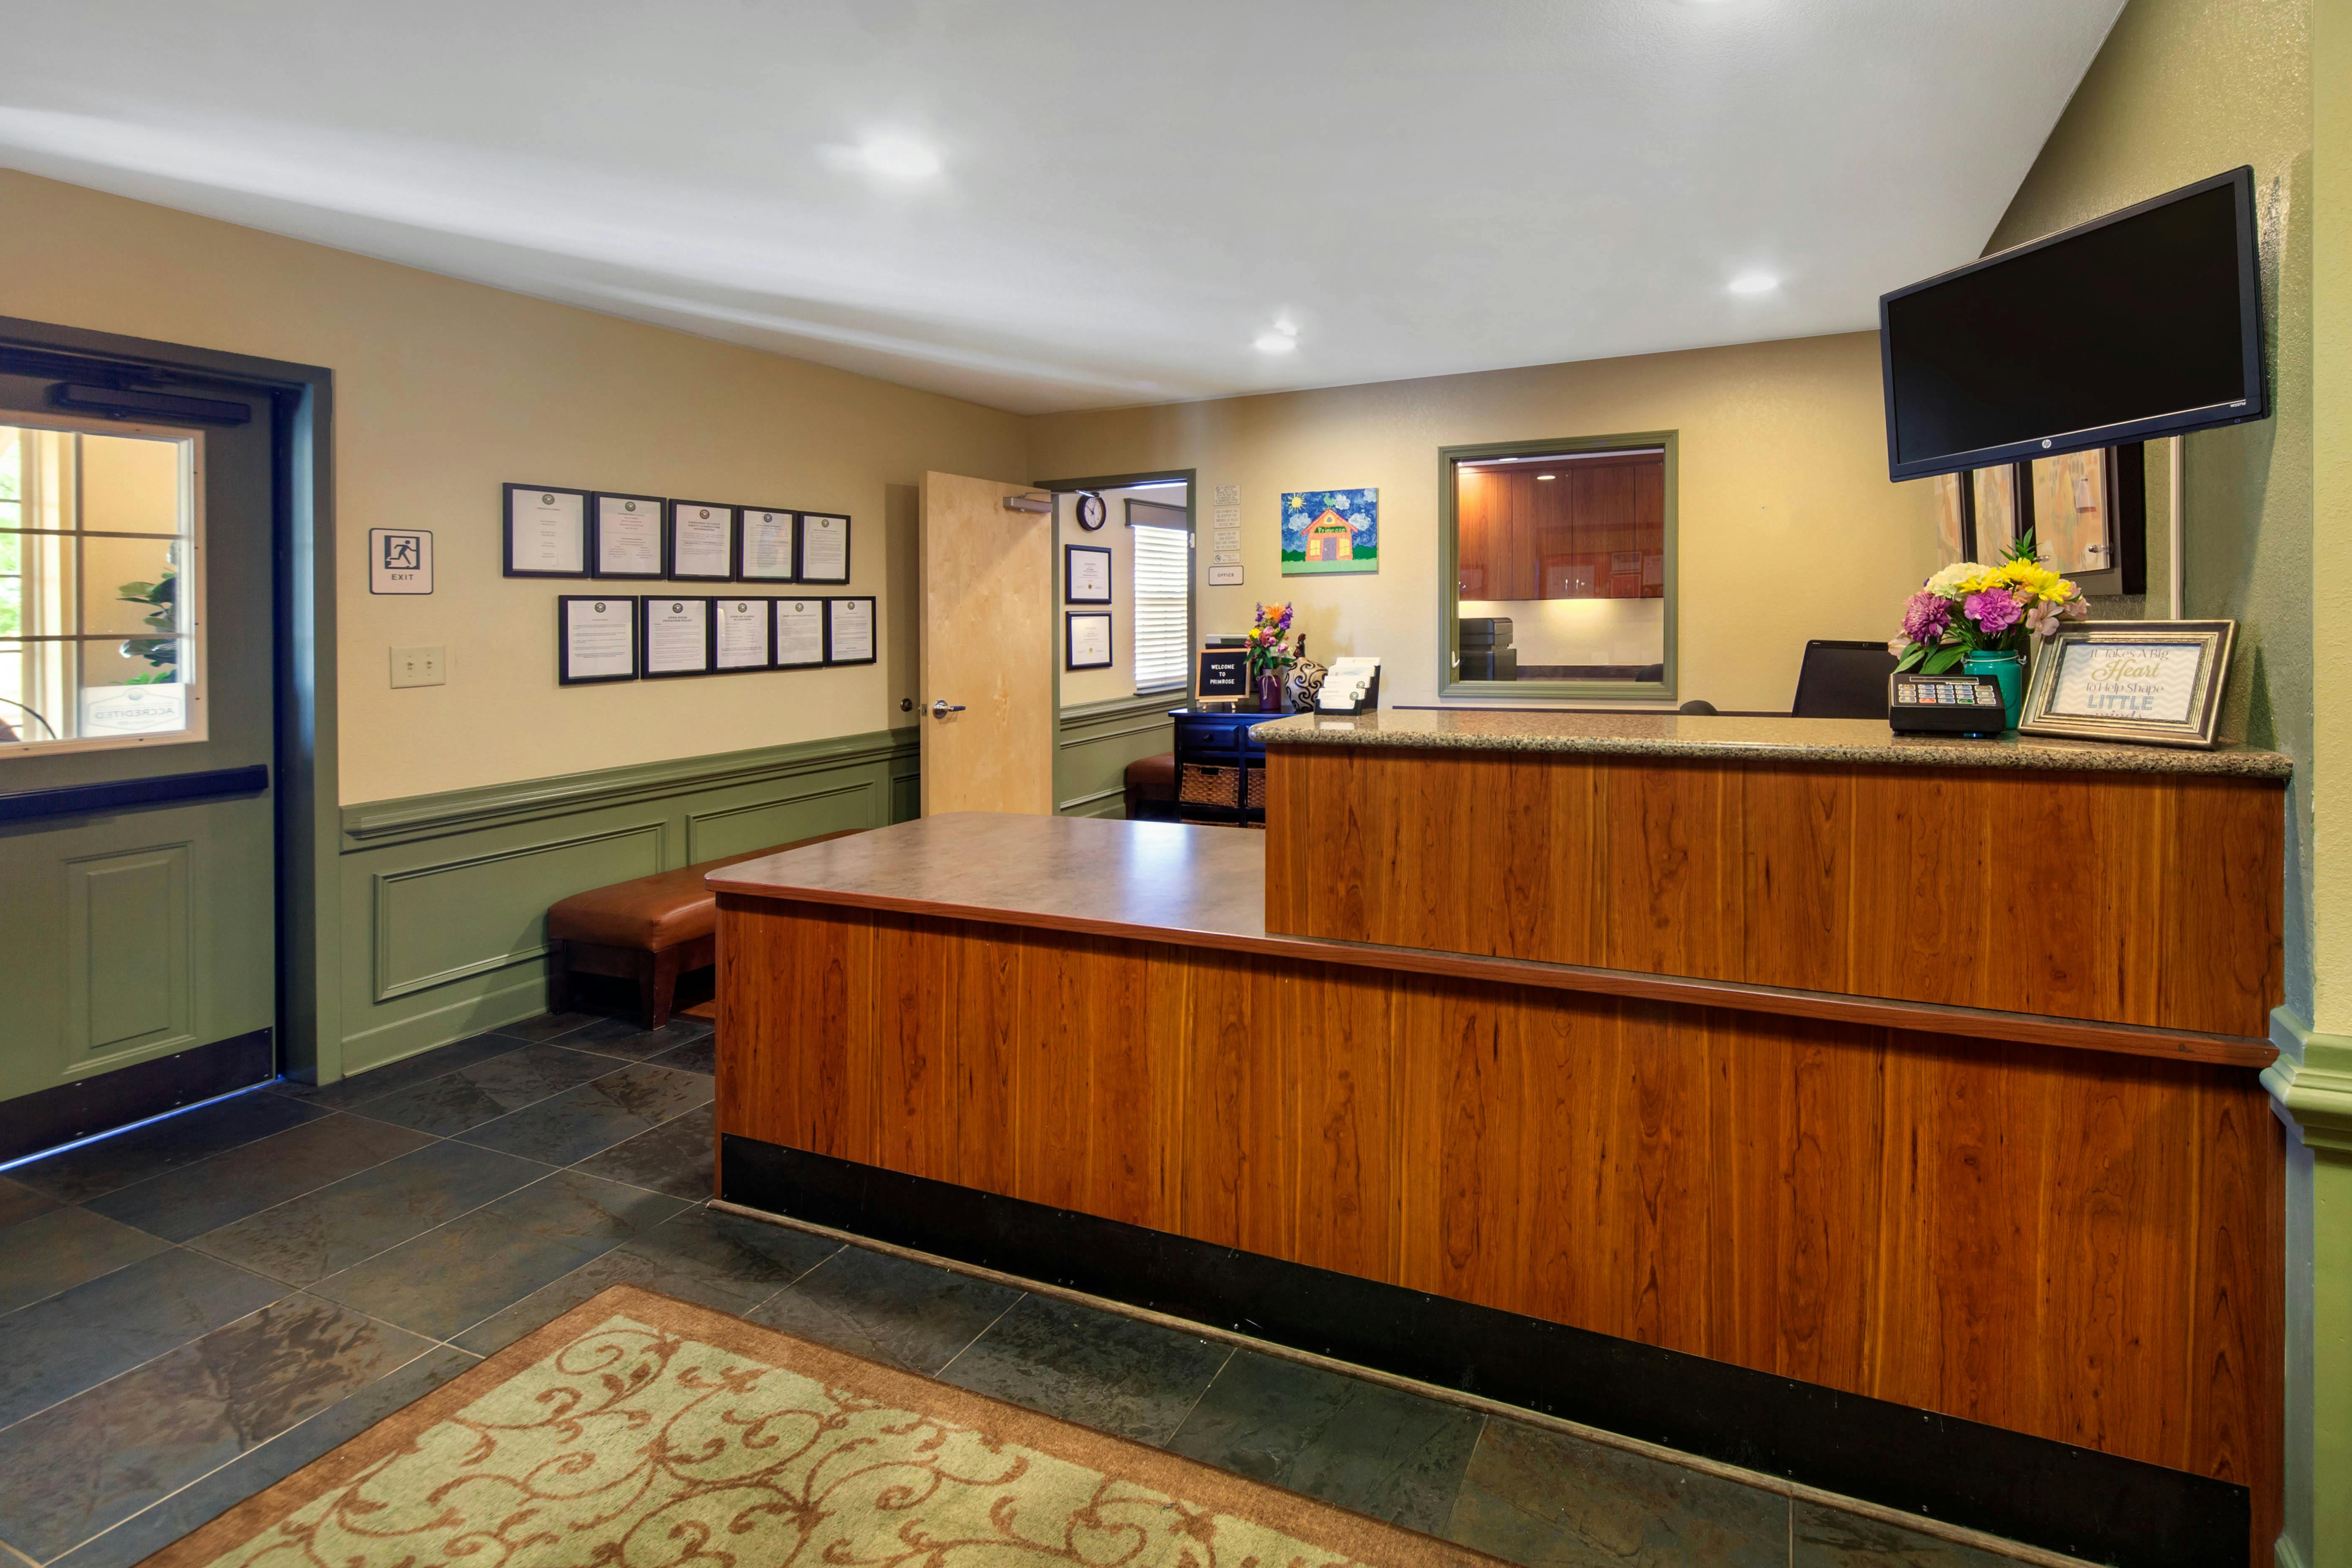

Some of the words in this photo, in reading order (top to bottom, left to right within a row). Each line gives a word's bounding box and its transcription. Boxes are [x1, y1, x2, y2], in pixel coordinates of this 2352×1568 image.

[2043, 439, 2051, 448] hp
[2090, 649, 2097, 658] It
[2103, 649, 2135, 658] Takes
[2138, 649, 2146, 658] A
[2150, 649, 2169, 660] Big
[2091, 658, 2160, 682] Heart
[2085, 682, 2097, 691] To
[2098, 682, 2124, 694] Help
[2127, 682, 2164, 696] Shape
[2087, 694, 2154, 711] LITTLE
